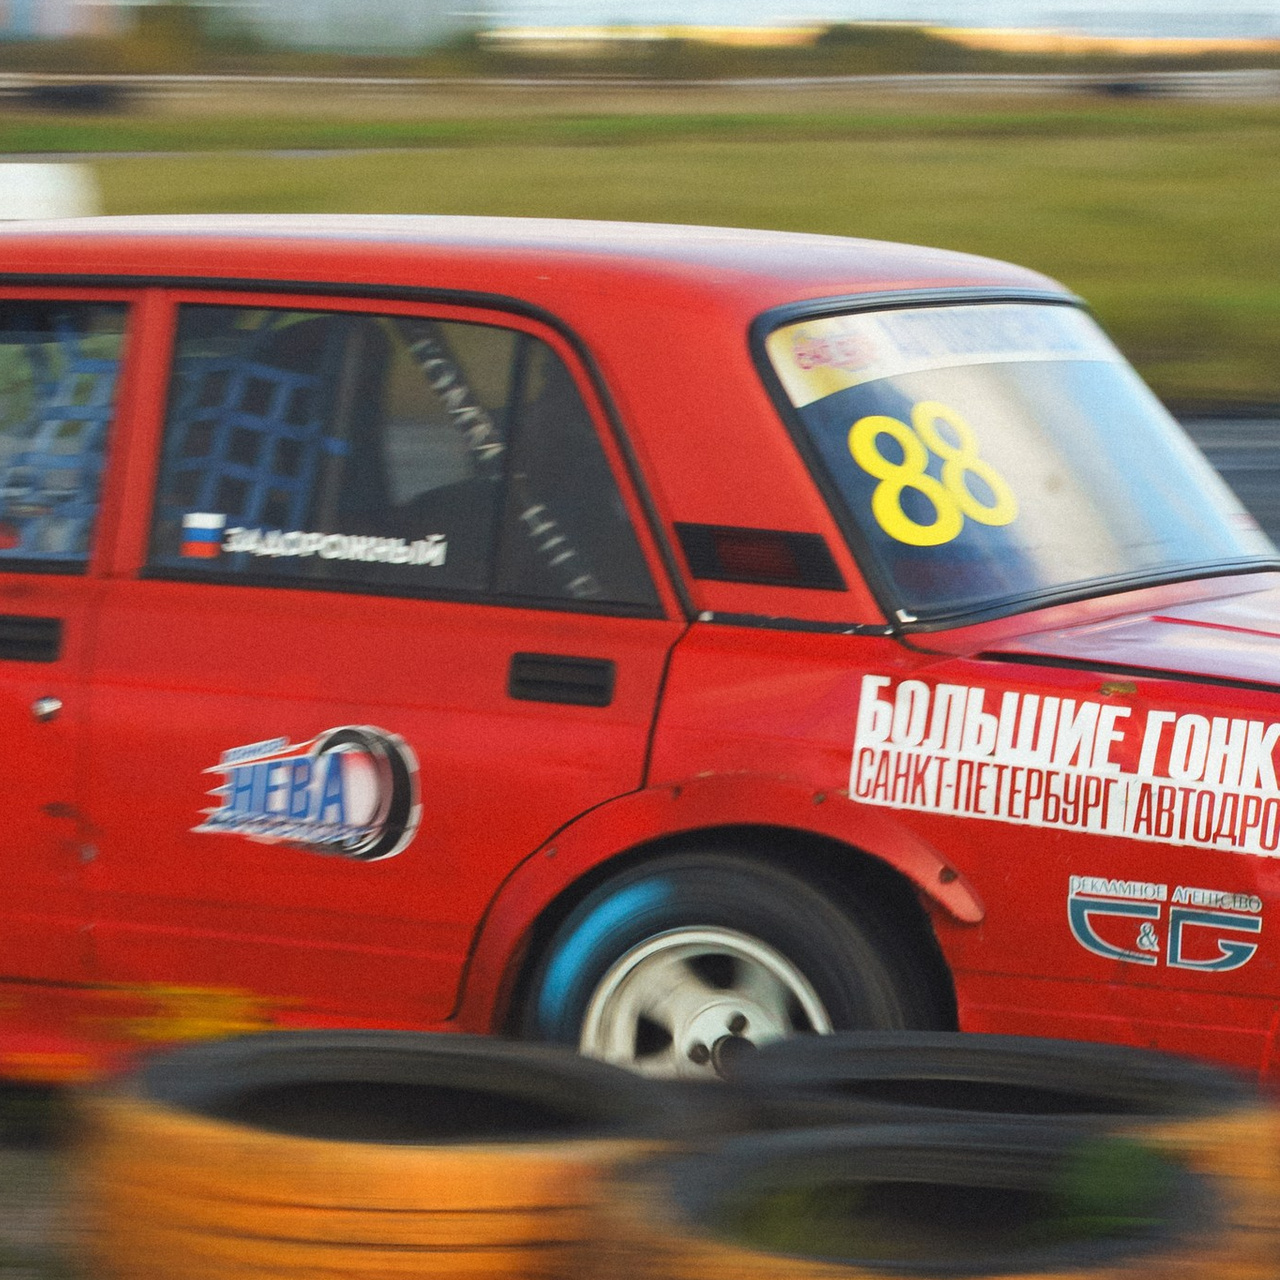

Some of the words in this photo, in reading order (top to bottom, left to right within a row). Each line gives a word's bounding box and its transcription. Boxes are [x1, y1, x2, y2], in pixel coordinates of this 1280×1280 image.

[847, 400, 1018, 547] 88
[859, 674, 1132, 774] БОЛЬШИЕ
[229, 751, 345, 826] НЕВА
[855, 747, 1119, 831] САНКТ-ПЕТЕРБУРГ
